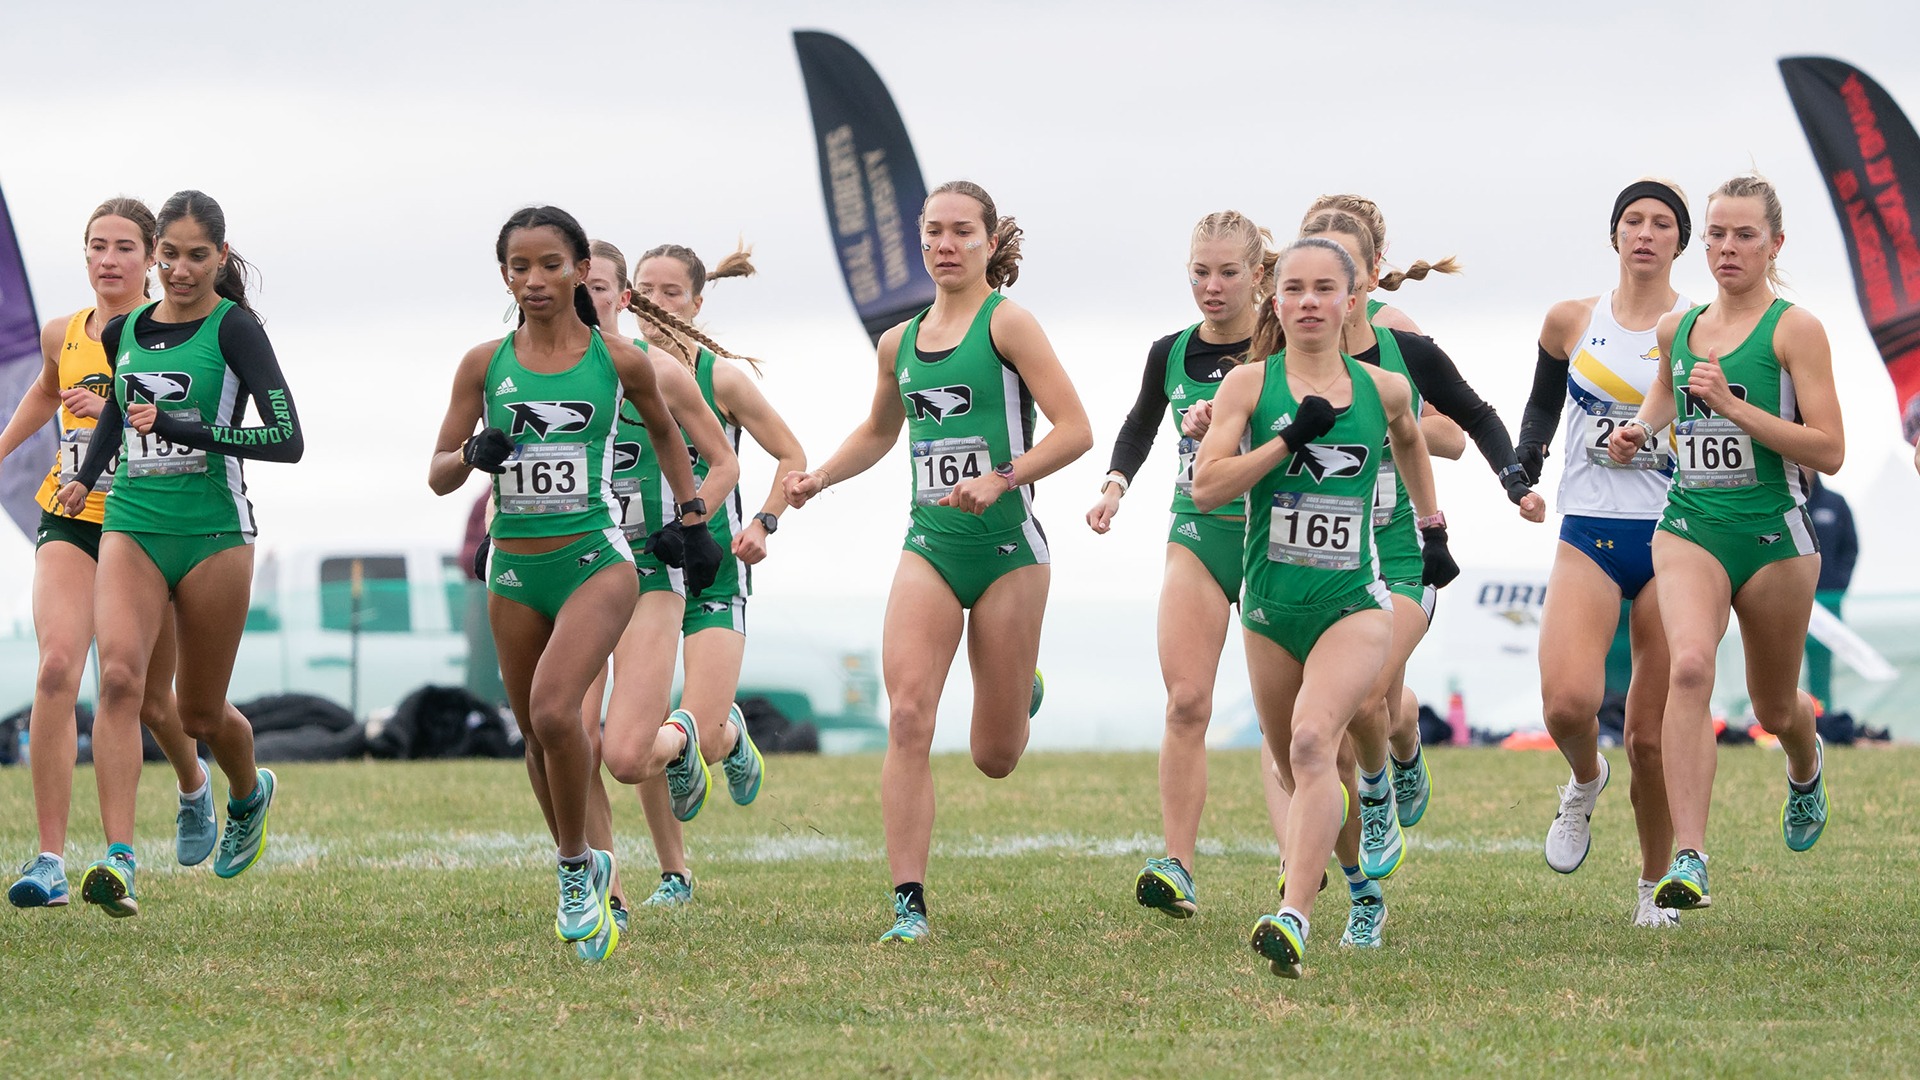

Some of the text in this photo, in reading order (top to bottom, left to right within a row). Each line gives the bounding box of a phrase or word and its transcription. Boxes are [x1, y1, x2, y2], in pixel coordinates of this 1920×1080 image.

[495, 386, 518, 397] adidas
[268, 388, 294, 440] NORTH
[211, 426, 282, 445] DAKOTA
[1685, 437, 1742, 469] 166
[510, 461, 576, 494] 163
[925, 452, 981, 488] 164
[1177, 527, 1201, 541] adidas
[1284, 511, 1351, 550] 165
[496, 578, 522, 587] adidas
